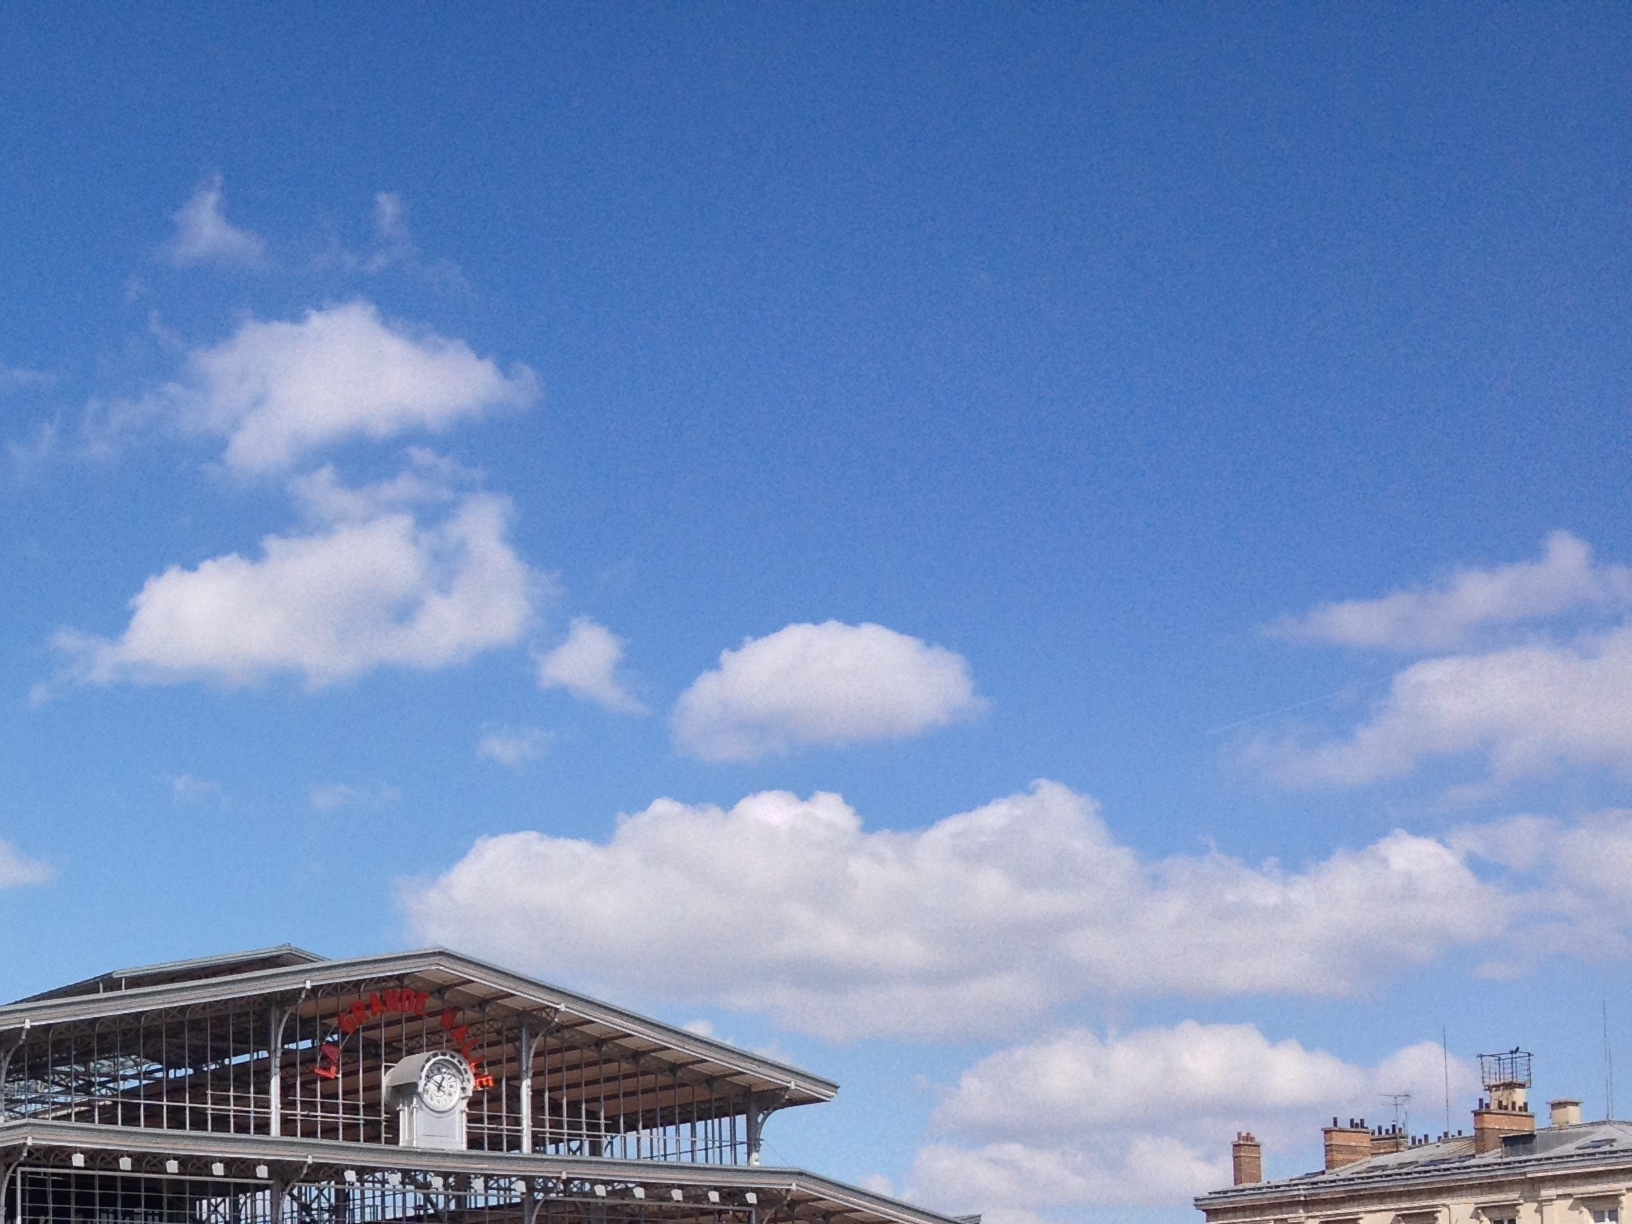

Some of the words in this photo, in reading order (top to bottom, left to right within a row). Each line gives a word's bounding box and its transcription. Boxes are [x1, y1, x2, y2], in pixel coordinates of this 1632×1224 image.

[314, 1043, 342, 1079] LA
[338, 987, 430, 1034] GRANDE
[439, 1008, 495, 1090] HALLE
